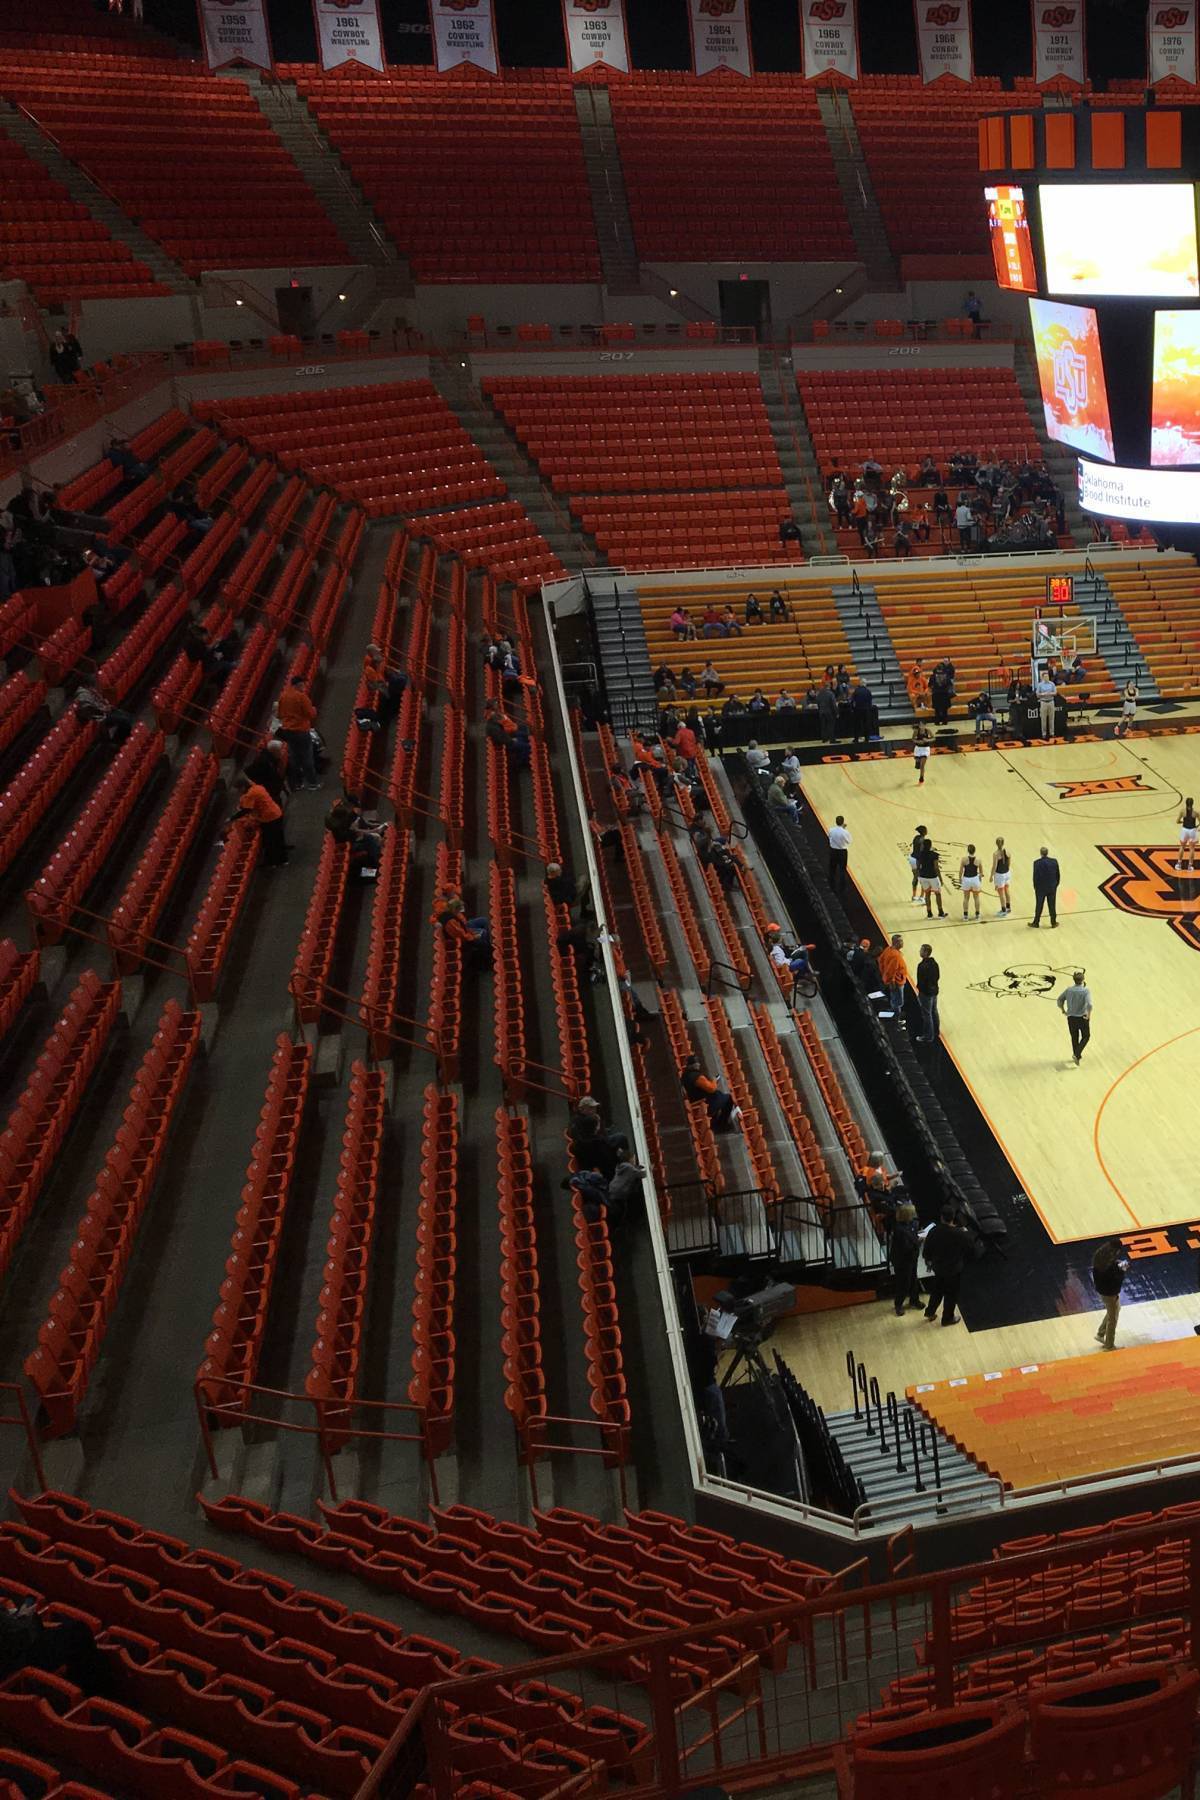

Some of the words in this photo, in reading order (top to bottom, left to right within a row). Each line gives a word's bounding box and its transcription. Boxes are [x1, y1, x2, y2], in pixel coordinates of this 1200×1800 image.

[336, 17, 360, 28] 1961
[450, 20, 475, 30] 1962
[583, 21, 607, 30] 1963
[332, 30, 365, 38] COWBOY
[448, 32, 480, 41] COWBOY
[581, 33, 612, 41] COWBOY
[818, 29, 840, 39] 1966
[706, 37, 735, 45] COWBOY
[1050, 35, 1069, 45] 1971
[1162, 37, 1182, 46] 1976
[1159, 47, 1185, 55] COWBOY
[889, 347, 921, 355] 208
[600, 352, 634, 361] 207
[295, 364, 326, 376] 206
[1105, 493, 1151, 508] Institute
